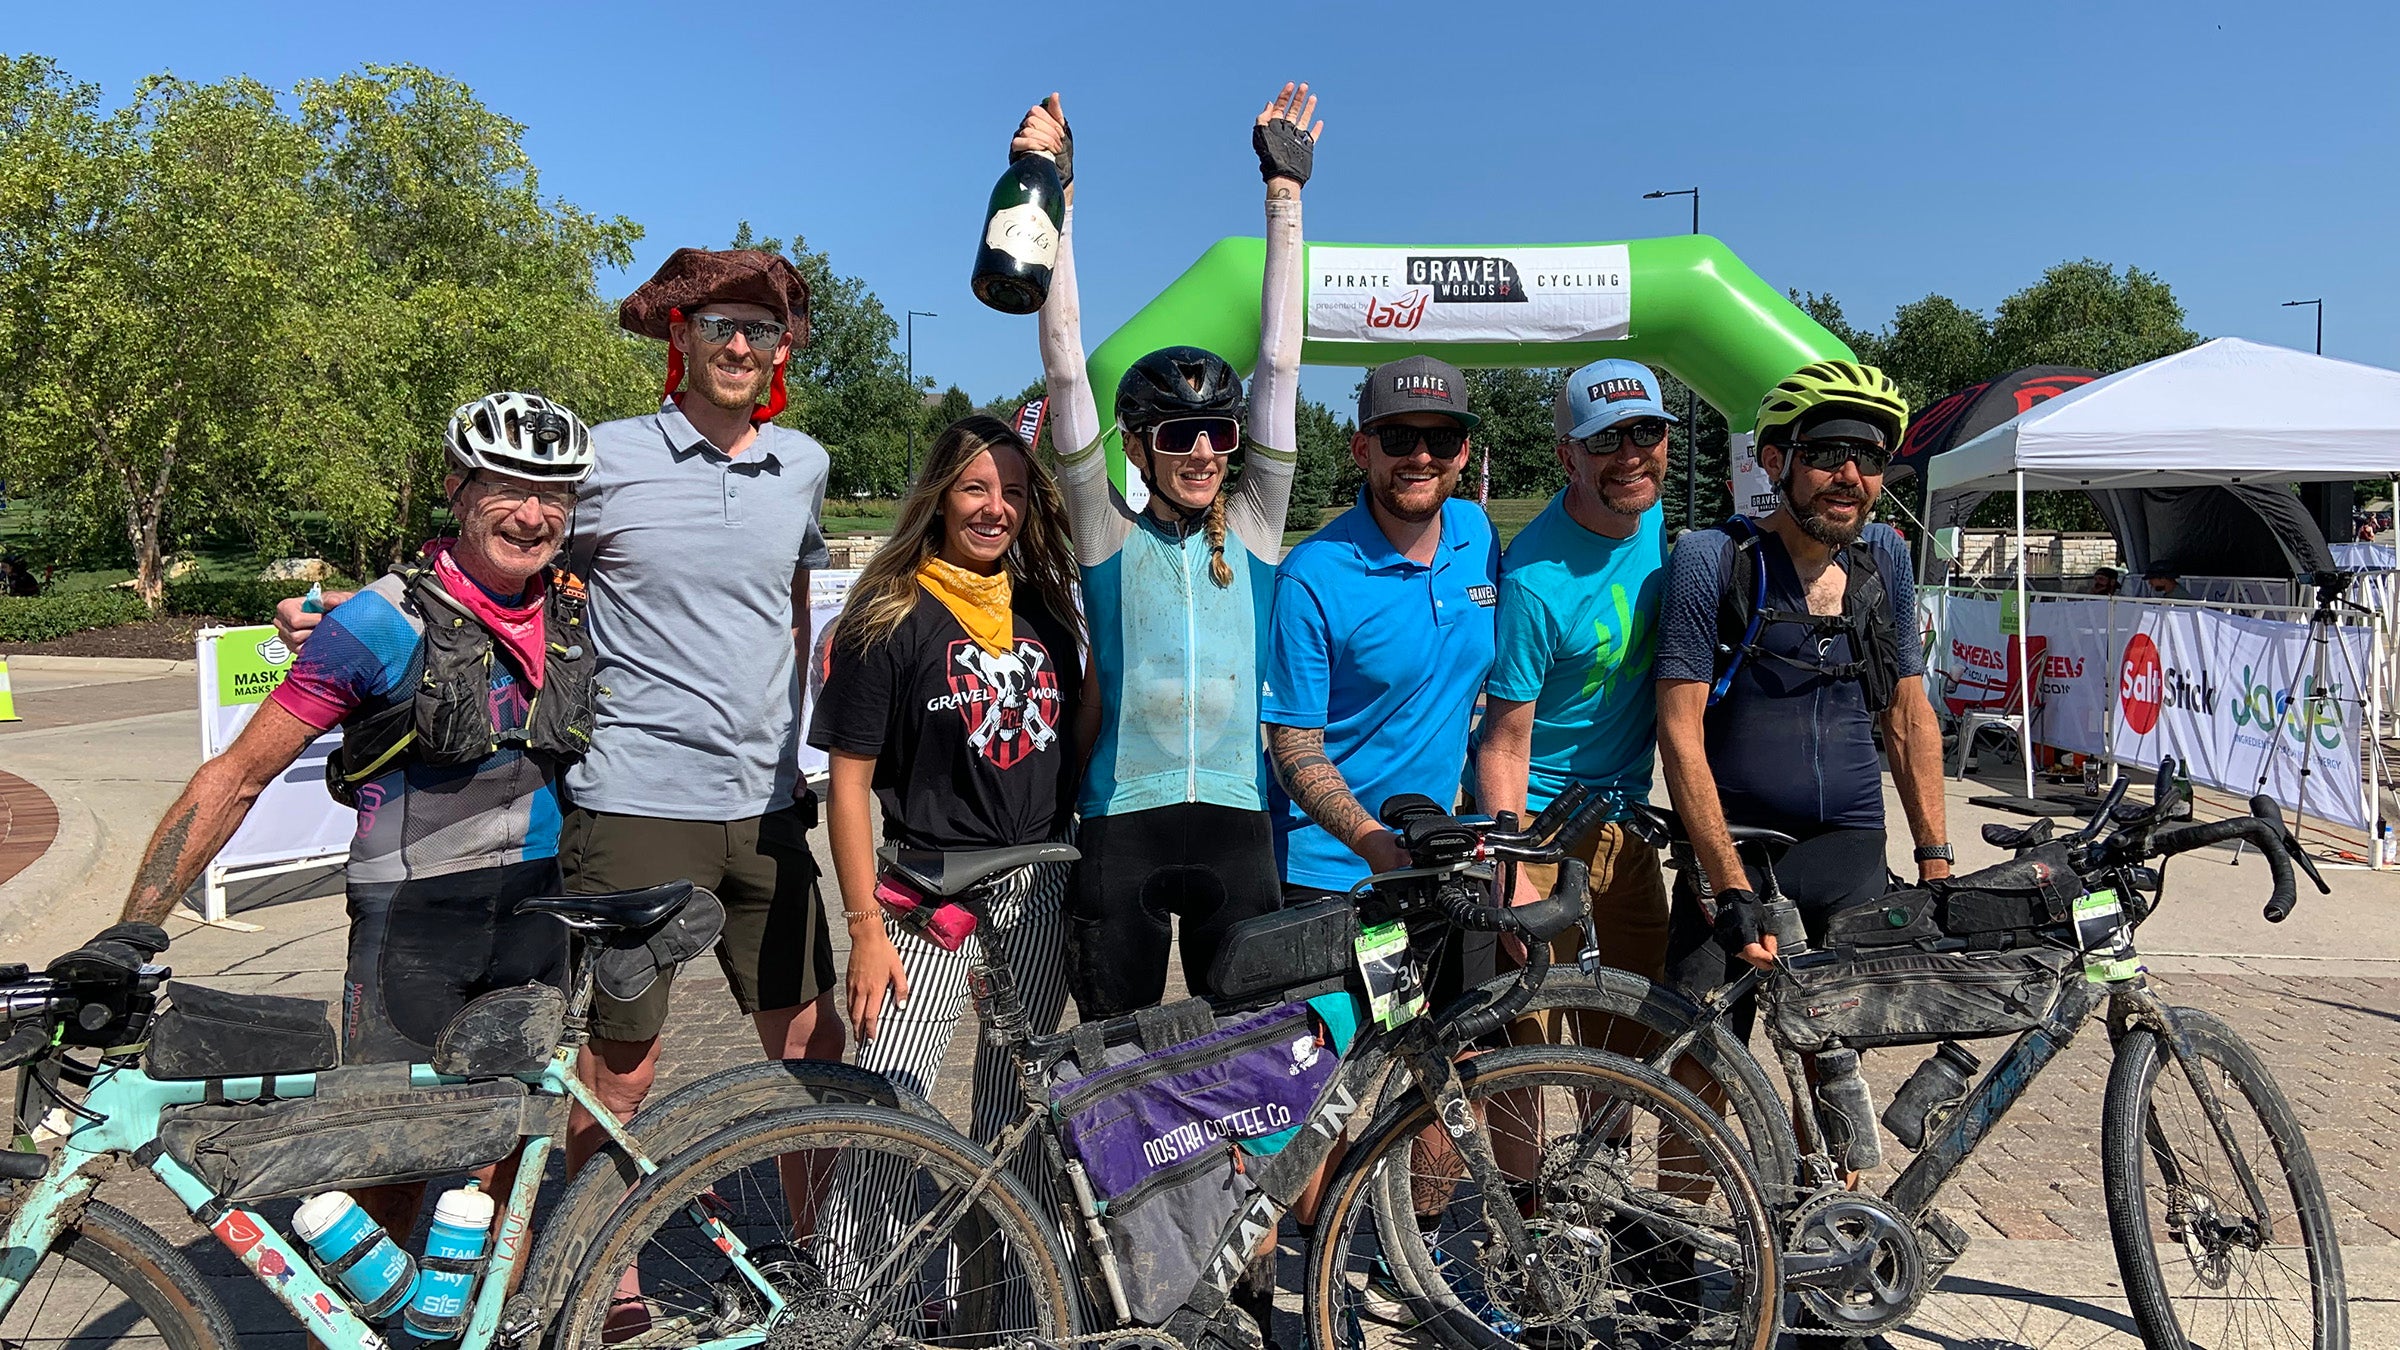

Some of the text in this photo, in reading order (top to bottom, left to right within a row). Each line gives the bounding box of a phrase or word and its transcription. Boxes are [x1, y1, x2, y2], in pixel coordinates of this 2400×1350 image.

[1412, 259, 1511, 282] GRAVEL
[1324, 274, 1619, 288] PIRATE CYCLING
[1441, 284, 1495, 297] WORLDS
[1316, 302, 1368, 311] presented by
[1397, 375, 1445, 391] PIRATE
[1592, 379, 1640, 398] PIRATE
[1468, 586, 1495, 601] GRAVEL
[2044, 656, 2085, 678] EELS
[234, 670, 279, 686] MASK
[235, 685, 271, 696] MASKS
[927, 689, 992, 712] GRAVEL
[1000, 708, 1022, 729] PCL
[1142, 1102, 1291, 1168] NOSTRA COFFEE Co
[498, 1206, 525, 1262] LAUF
[440, 1246, 476, 1259] TEAM
[1785, 1265, 1842, 1280] ULTEGRA
[422, 1294, 461, 1314] SiS
[510, 1320, 540, 1341] SHIMANO
